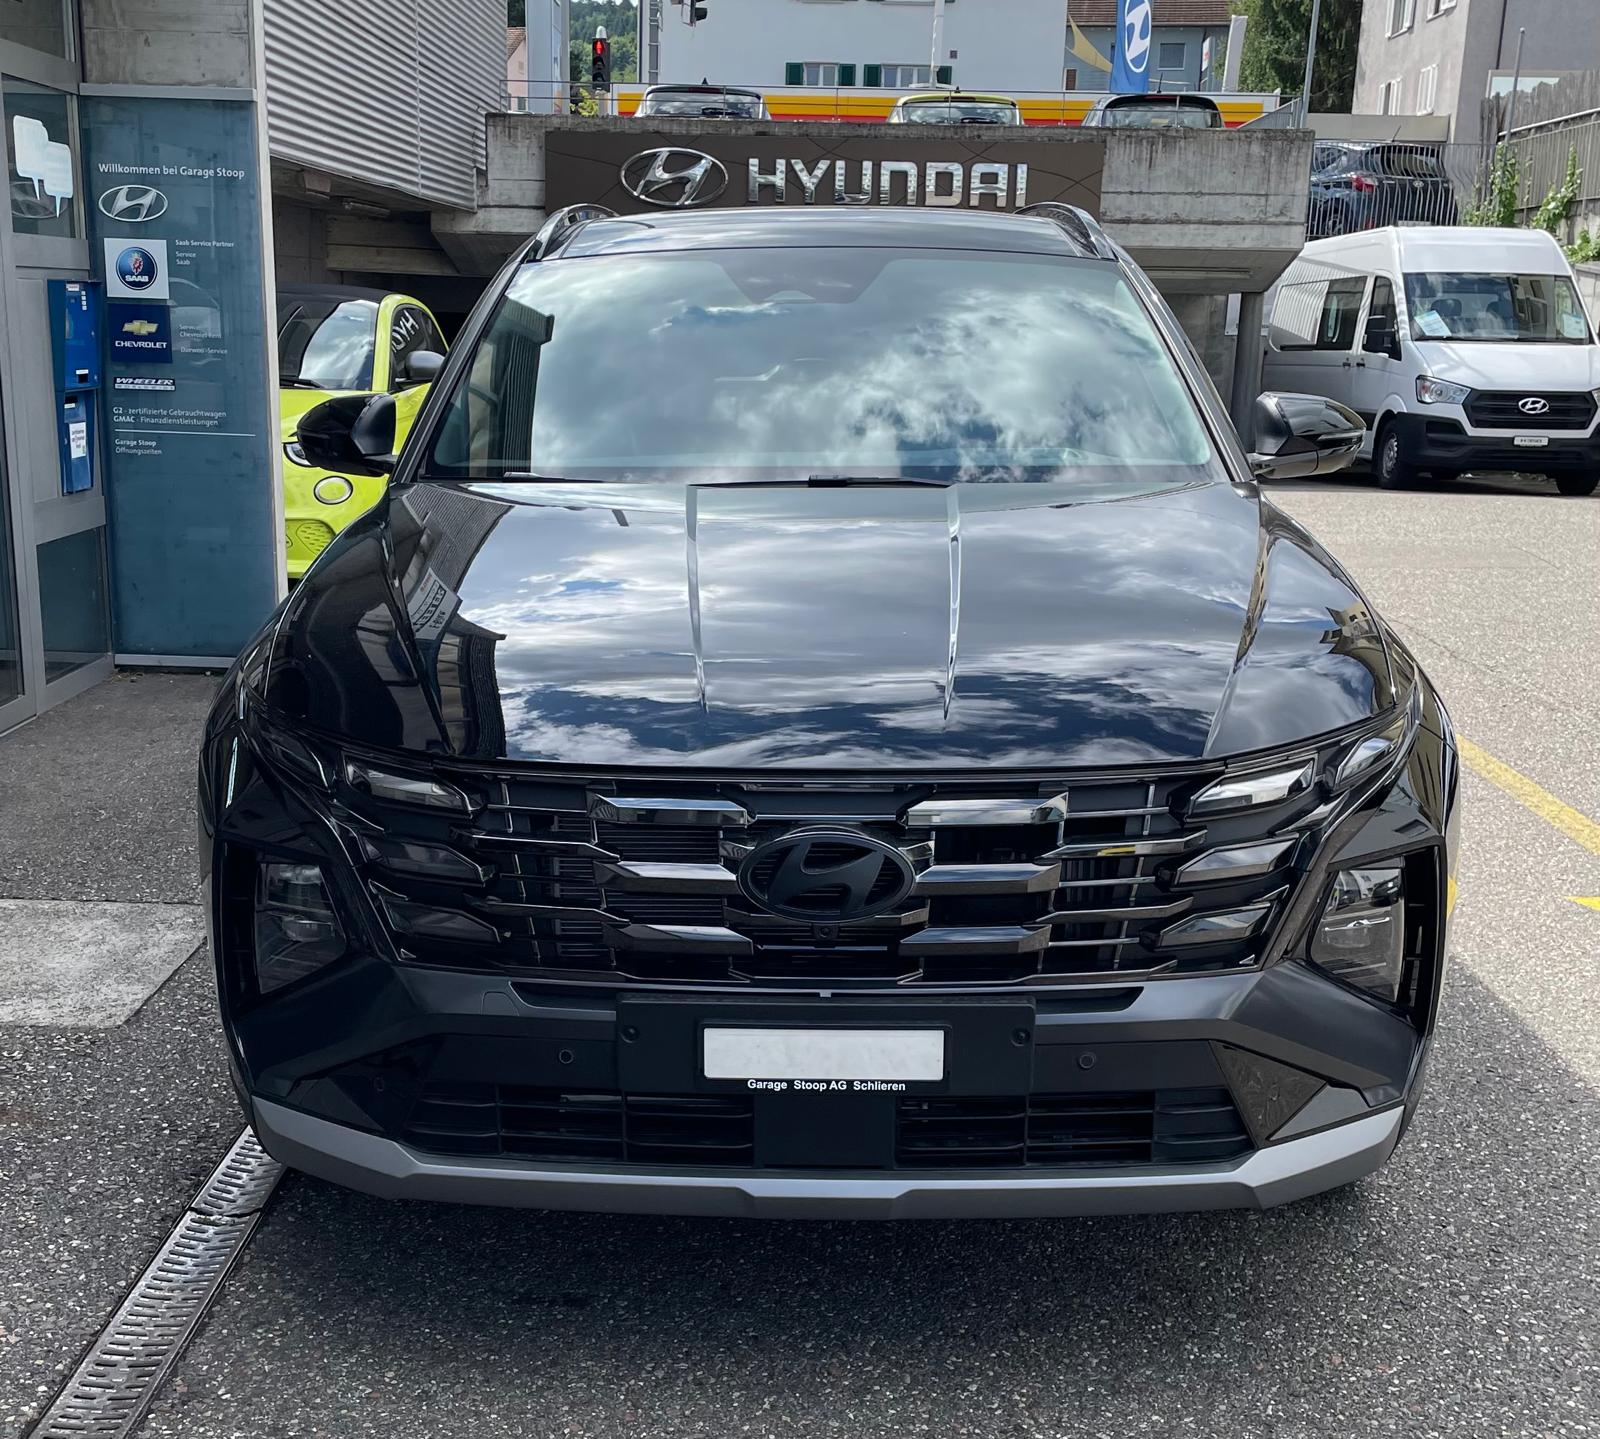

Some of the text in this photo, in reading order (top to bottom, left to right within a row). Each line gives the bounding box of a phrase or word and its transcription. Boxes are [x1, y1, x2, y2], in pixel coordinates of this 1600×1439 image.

[98, 163, 245, 180] Willkommen bei Garage Stoop
[748, 157, 1029, 208] HYUNDAI
[175, 239, 190, 247] Saab
[190, 240, 212, 248] Service
[176, 258, 191, 266] Saab
[115, 340, 167, 349] CHEVROLET
[116, 377, 174, 386] WHEELER
[113, 406, 123, 414] G2
[128, 407, 167, 416] zertifizierte
[168, 409, 227, 419] Gebrauchtwagen
[113, 415, 135, 423] GMAC
[140, 416, 219, 427] Finanzdienstleistungen
[115, 438, 157, 447] Garage Stoop
[747, 1079, 906, 1092] Garage Stoop AG Schlieren
